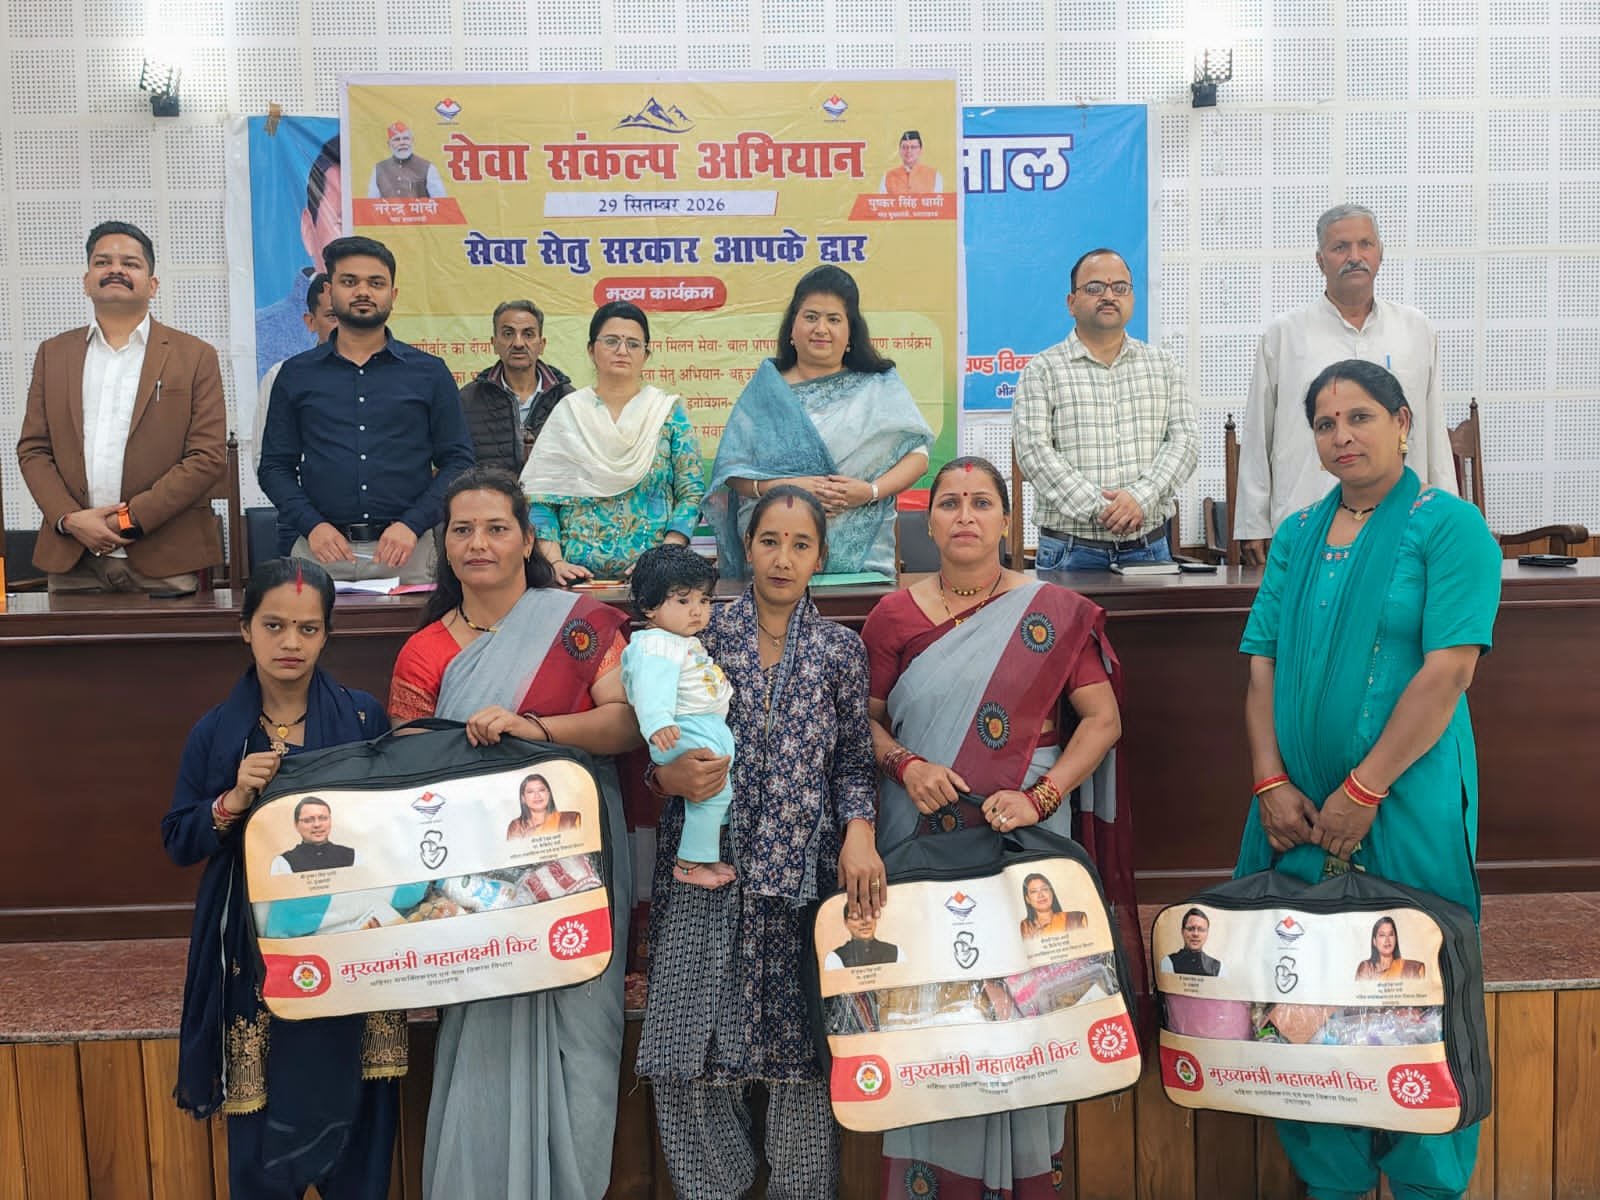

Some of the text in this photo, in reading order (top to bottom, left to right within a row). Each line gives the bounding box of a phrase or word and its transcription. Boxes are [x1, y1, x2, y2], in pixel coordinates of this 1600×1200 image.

[444, 132, 866, 181] सेवा संकल्प अभियान
[409, 198, 440, 215] मोदी
[599, 194, 726, 213] 29 सितम्बर 2026
[464, 229, 868, 275] सेवा सेतु सरकार आपके द्वार
[649, 281, 715, 302] कार्यक्रम
[666, 336, 694, 352] मिलन
[728, 340, 749, 352] बाल
[892, 332, 932, 350] कार्यक्रम
[340, 936, 538, 983] मुख्यमंत्री महालक्ष्मी किट
[899, 1041, 1080, 1086] मुख्यमंत्री महालक्ष्मी किट
[1209, 1065, 1378, 1092] मुख्यमंत्री महालक्ष्मी किट
